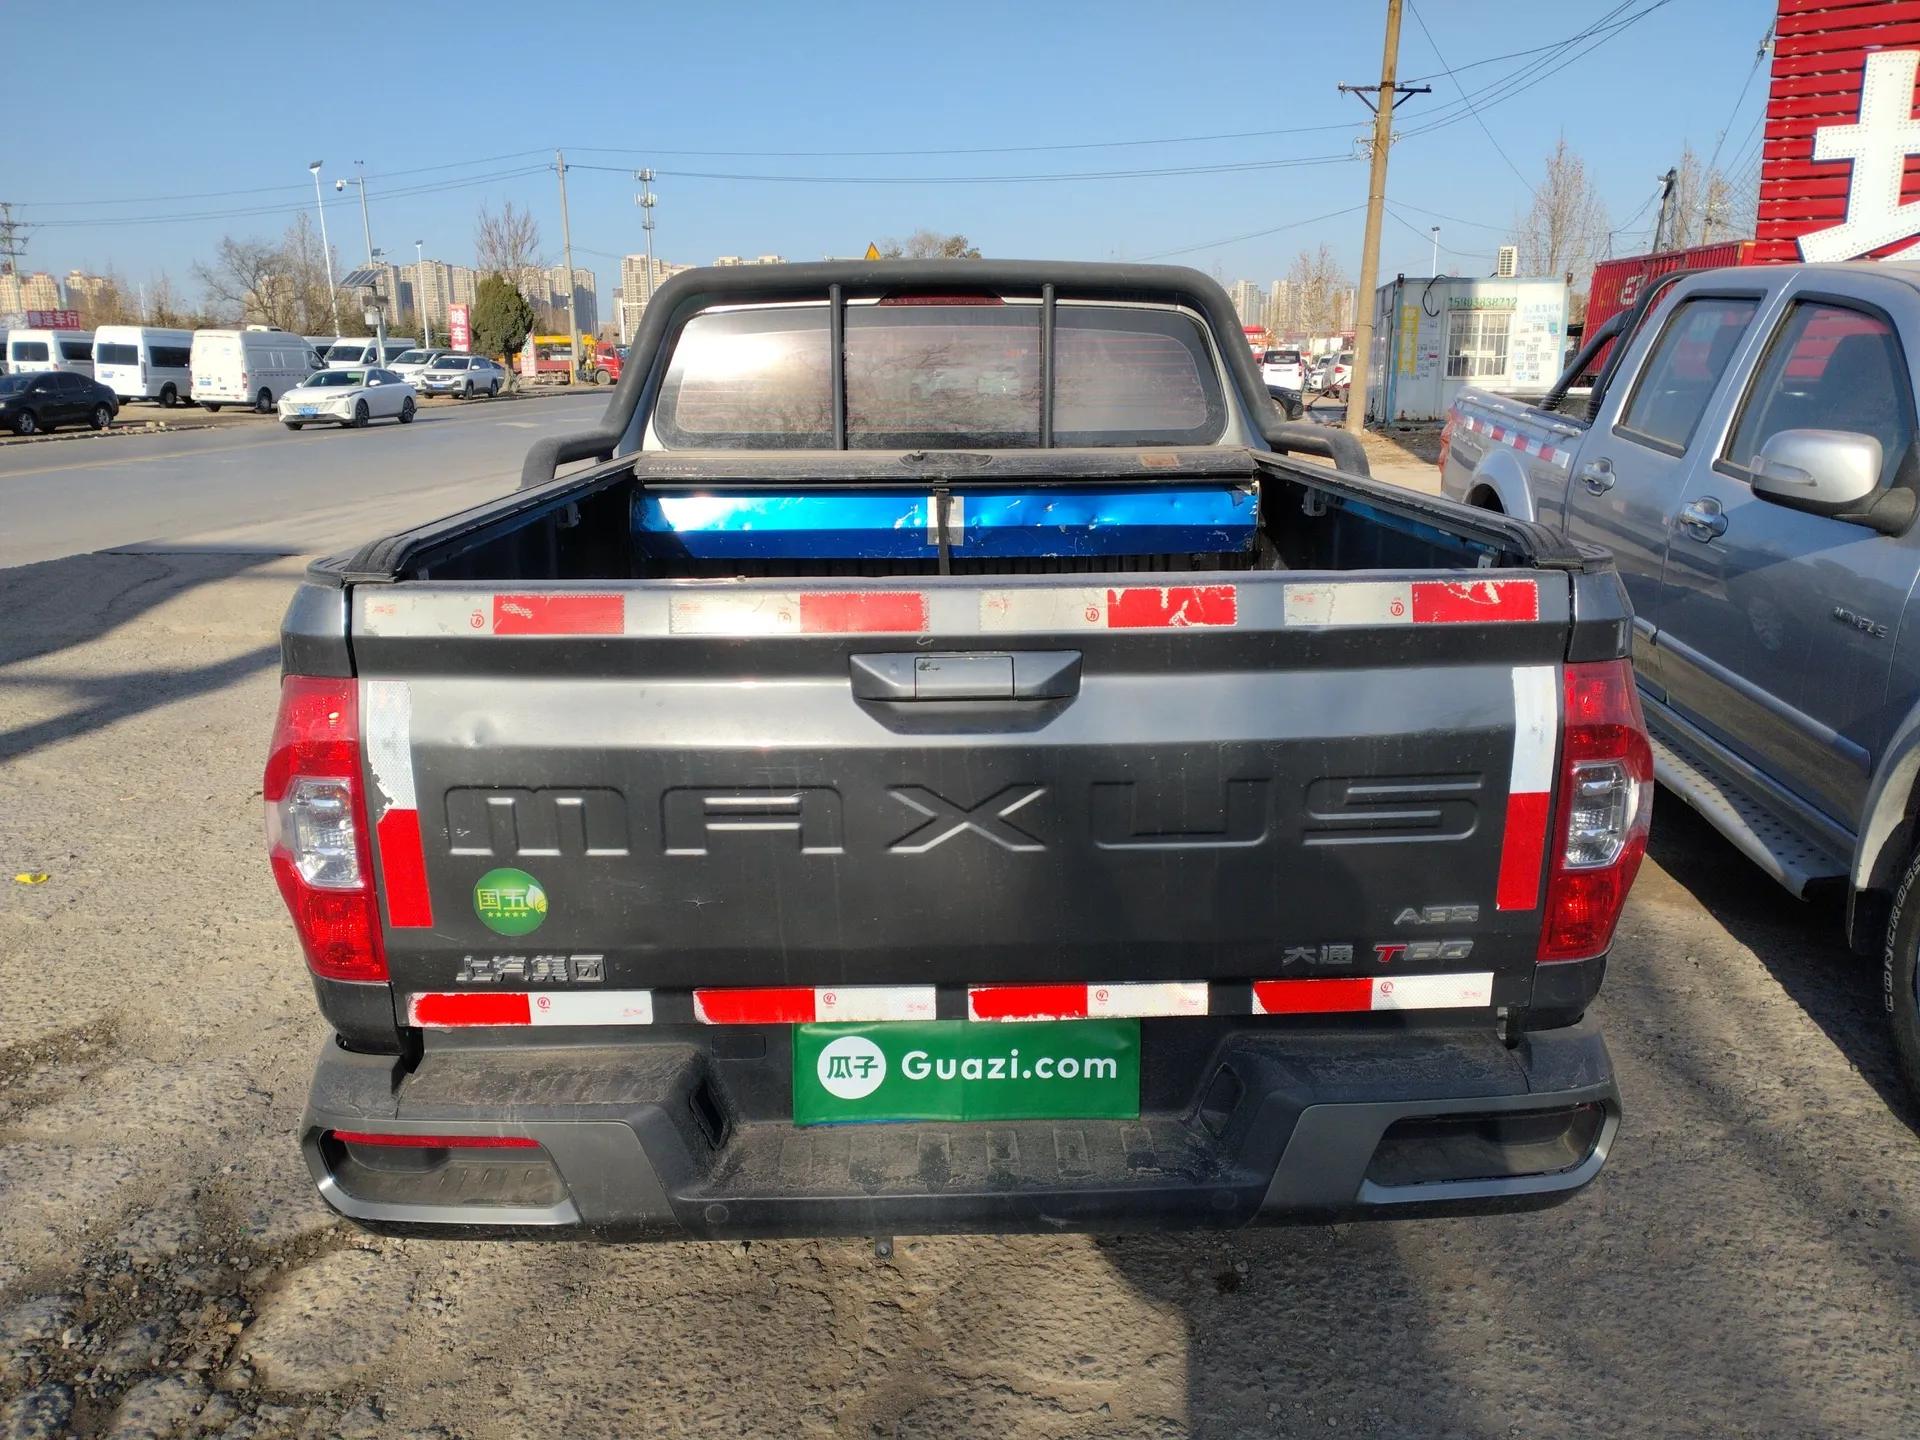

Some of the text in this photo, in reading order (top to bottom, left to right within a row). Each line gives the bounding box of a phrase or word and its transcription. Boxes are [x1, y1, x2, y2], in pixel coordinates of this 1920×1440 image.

[444, 775, 1483, 858] MAXUS
[477, 888, 530, 911] 国五
[1393, 904, 1480, 925] ABS
[1281, 940, 1475, 966] 大通 T60
[456, 954, 607, 983] 上汽集团
[827, 1048, 1118, 1081] 瓜子 Guazi.com
